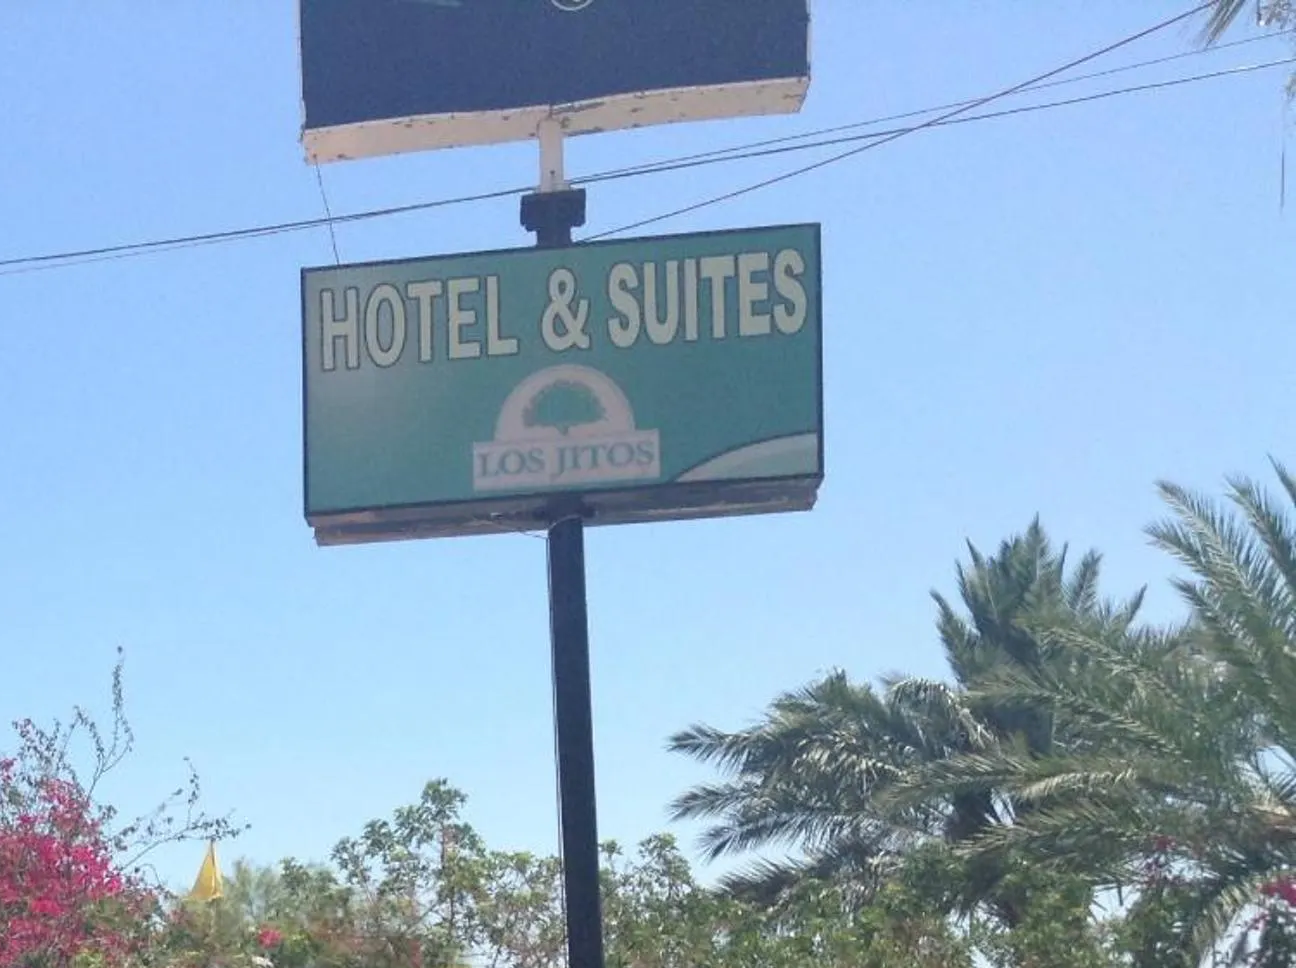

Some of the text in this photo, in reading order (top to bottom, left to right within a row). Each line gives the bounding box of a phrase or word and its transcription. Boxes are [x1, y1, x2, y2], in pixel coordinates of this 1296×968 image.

[319, 247, 808, 372] HOTEL & SUITES
[477, 441, 654, 478] LOS JITOS
